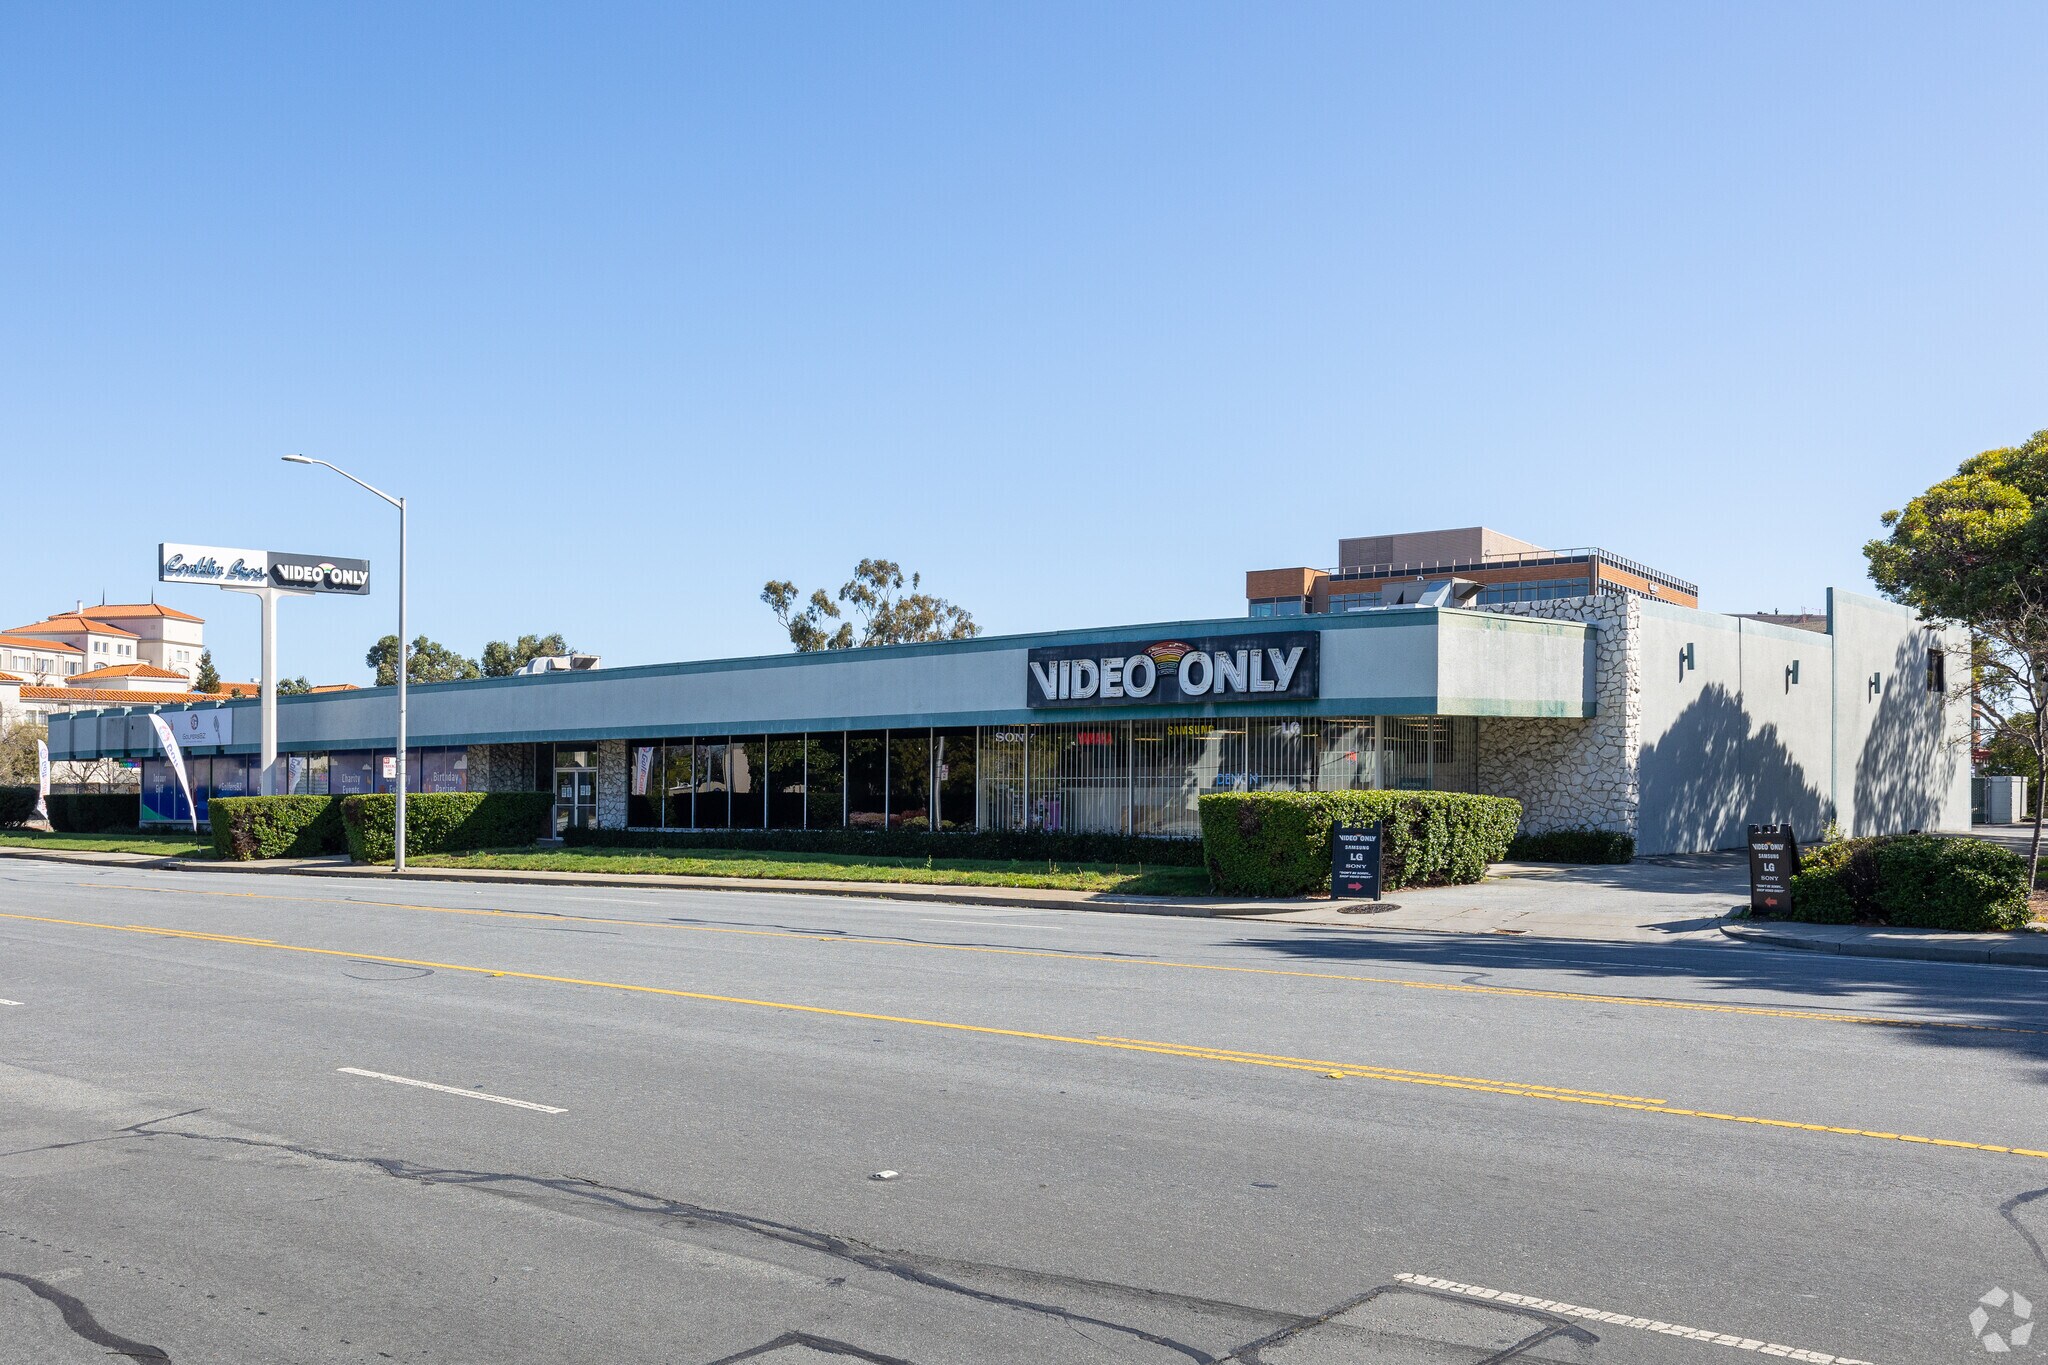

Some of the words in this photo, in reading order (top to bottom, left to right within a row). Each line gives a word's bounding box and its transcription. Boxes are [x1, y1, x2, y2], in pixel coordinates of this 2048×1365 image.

[165, 553, 224, 577] Conklin
[276, 564, 325, 583] VIDEO
[330, 570, 369, 585] ONLY
[1029, 654, 1156, 700] VIDEO
[1178, 646, 1305, 696] ONLY
[1167, 725, 1215, 736] SAMSUNG
[341, 773, 361, 785] Charity
[433, 772, 459, 783] Birthday
[342, 785, 360, 793] Events
[436, 784, 456, 793] Parties
[1339, 834, 1358, 842] VIDEO
[1350, 853, 1363, 861] LG
[1763, 862, 1775, 872] LG
